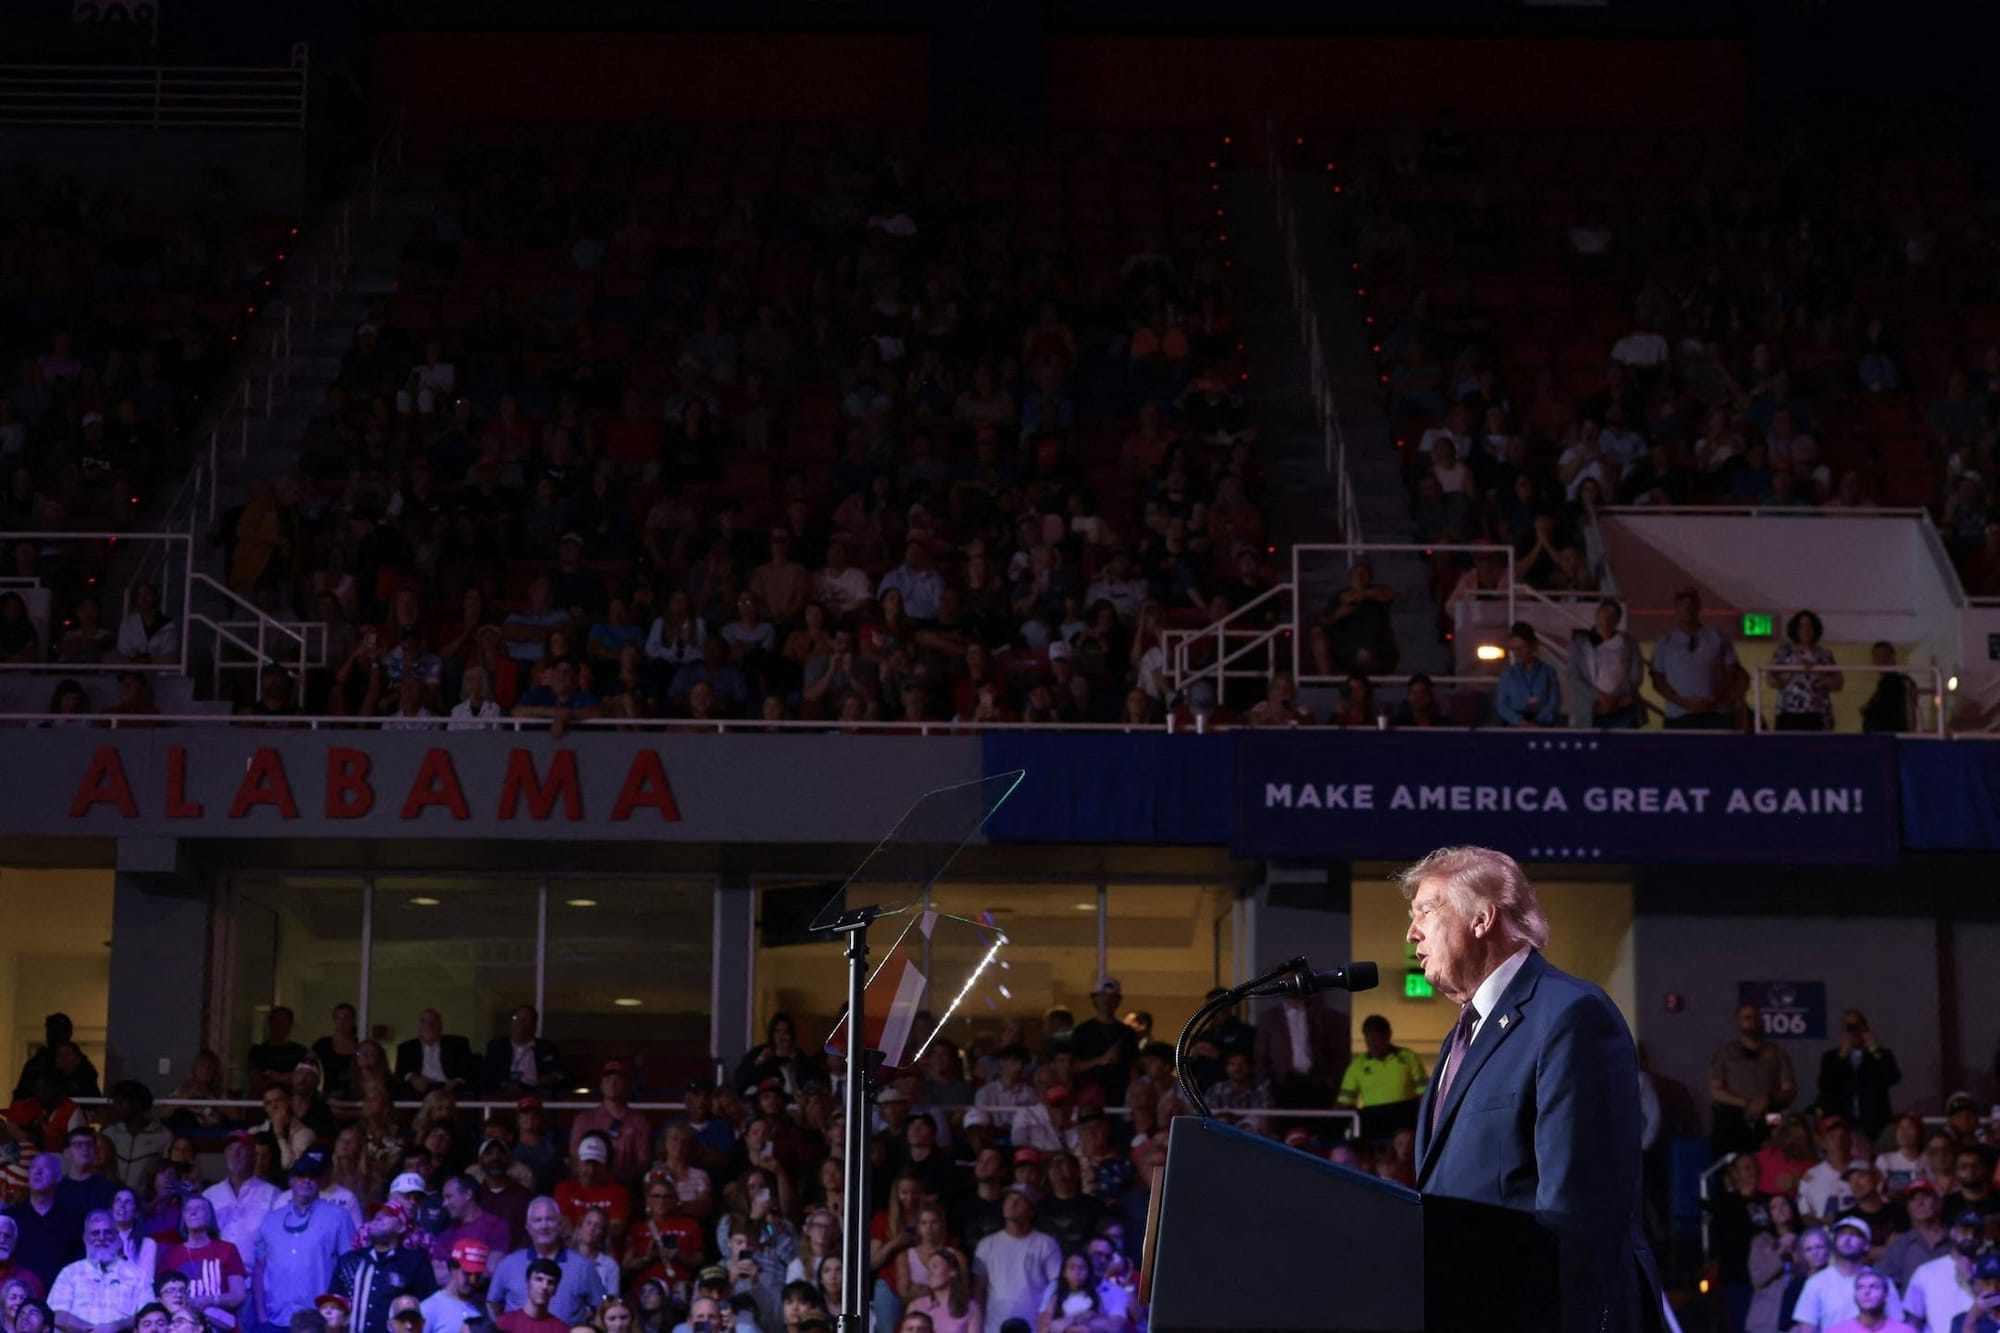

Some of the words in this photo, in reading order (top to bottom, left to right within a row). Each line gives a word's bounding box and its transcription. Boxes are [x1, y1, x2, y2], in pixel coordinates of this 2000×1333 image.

[68, 747, 681, 821] ALABAMA
[1265, 783, 1374, 809] MAKE
[1390, 785, 1568, 811] AMERICA
[1583, 787, 1710, 812] GREAT
[1726, 788, 1863, 813] AGAIN!
[1762, 1013, 1807, 1035] 106
